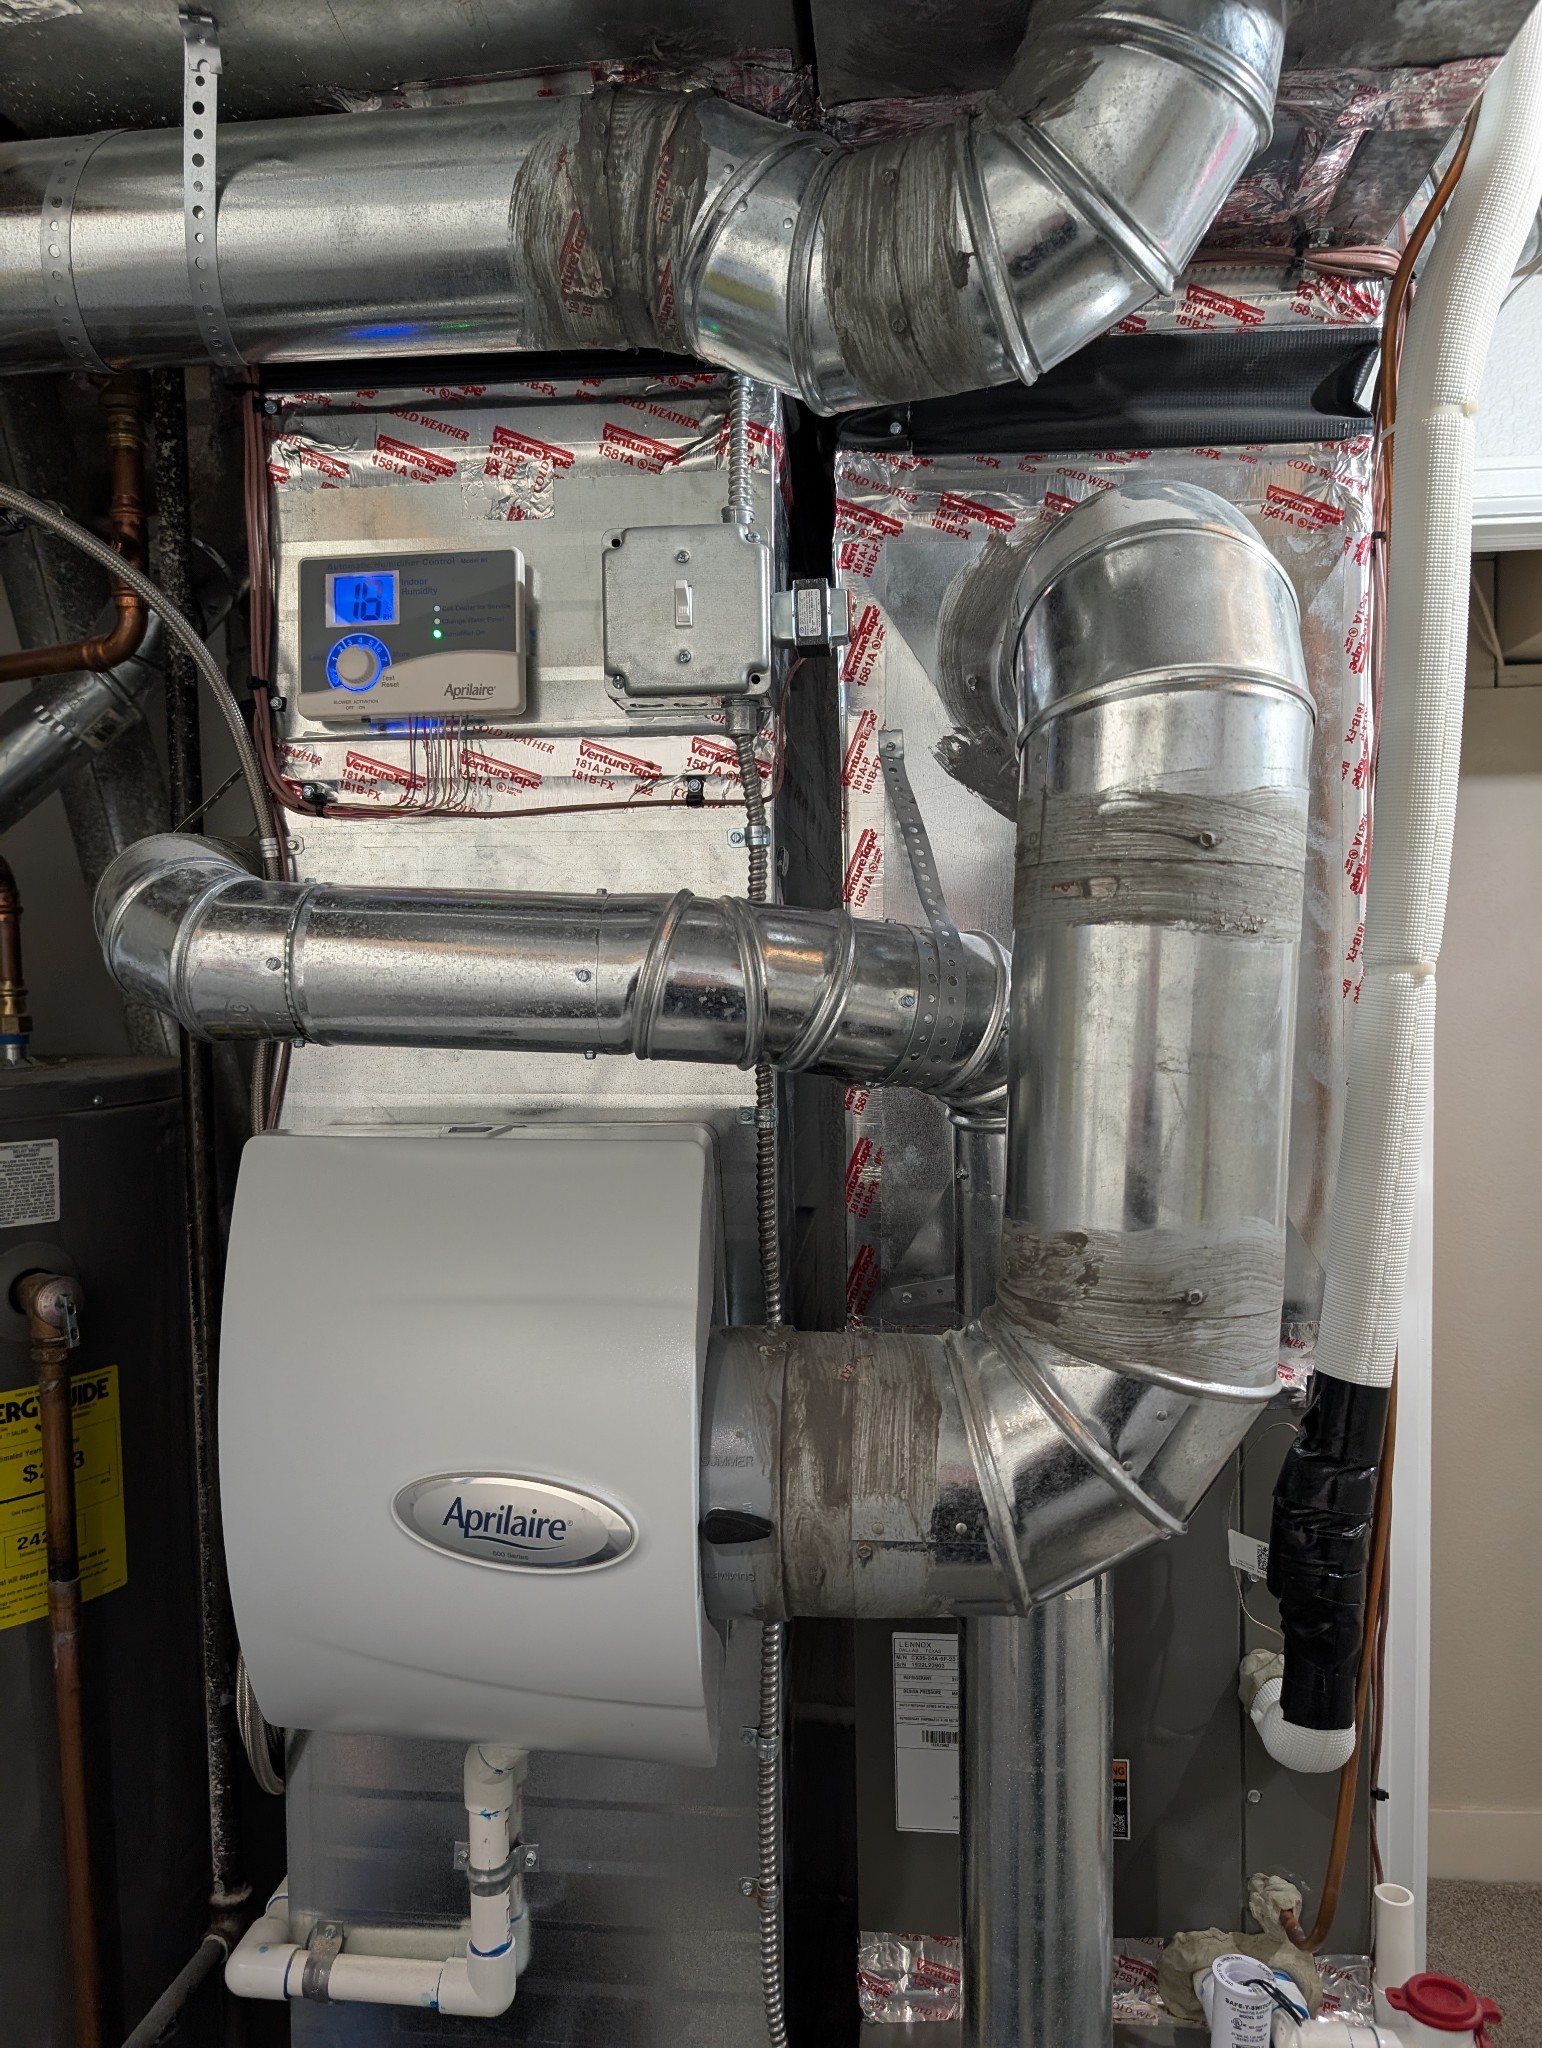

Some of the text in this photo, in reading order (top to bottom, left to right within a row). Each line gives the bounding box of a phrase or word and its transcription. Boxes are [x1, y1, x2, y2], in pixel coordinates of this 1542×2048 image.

[1179, 302, 1215, 321] 181A-P
[1185, 289, 1265, 326] VentureTape
[616, 395, 700, 430] COLD WEATHER
[390, 407, 470, 442] COLD WEATHER
[376, 438, 457, 477] VentureTape
[489, 444, 525, 463] 181A-P
[598, 443, 634, 466] 1581A
[372, 454, 407, 477] 1581A
[1056, 467, 1085, 482] COLD
[1287, 458, 1317, 475] COLD
[935, 508, 969, 526] 181A-P
[940, 495, 1016, 533] VentureTape
[1259, 503, 1294, 526] 1581A
[1265, 491, 1345, 526] VentureTape
[931, 518, 972, 541] 181B-FX
[422, 558, 455, 566] Control
[863, 543, 883, 579] 181B-F
[401, 578, 428, 586] Indoor
[401, 587, 438, 596] Humidity
[845, 605, 881, 683] VentureTape
[857, 653, 878, 687] 1581A
[443, 683, 496, 701] Aprilaire
[473, 724, 555, 754] COLD WEATHER
[843, 709, 877, 787] VentureTape
[346, 755, 427, 792] VentureTape
[460, 752, 543, 790] VentureTape
[575, 757, 612, 776] 181A-P
[579, 745, 662, 781] VentureTape
[686, 756, 722, 777] 1581A
[852, 757, 871, 791] 181A-P
[342, 769, 378, 787] 181A-P
[571, 769, 616, 791] 181B-FX
[339, 780, 382, 801] 181B-FX
[844, 829, 878, 903] VentureTape
[854, 875, 875, 908] 1581A
[700, 1455, 754, 1468] SUMMER
[442, 1496, 574, 1542] Aprilaire
[492, 1550, 529, 1561] 600 Series
[899, 1641, 932, 1649] LENNOX
[1113, 1970, 1146, 1989] 1581A
[1113, 2001, 1133, 2014] OLD
